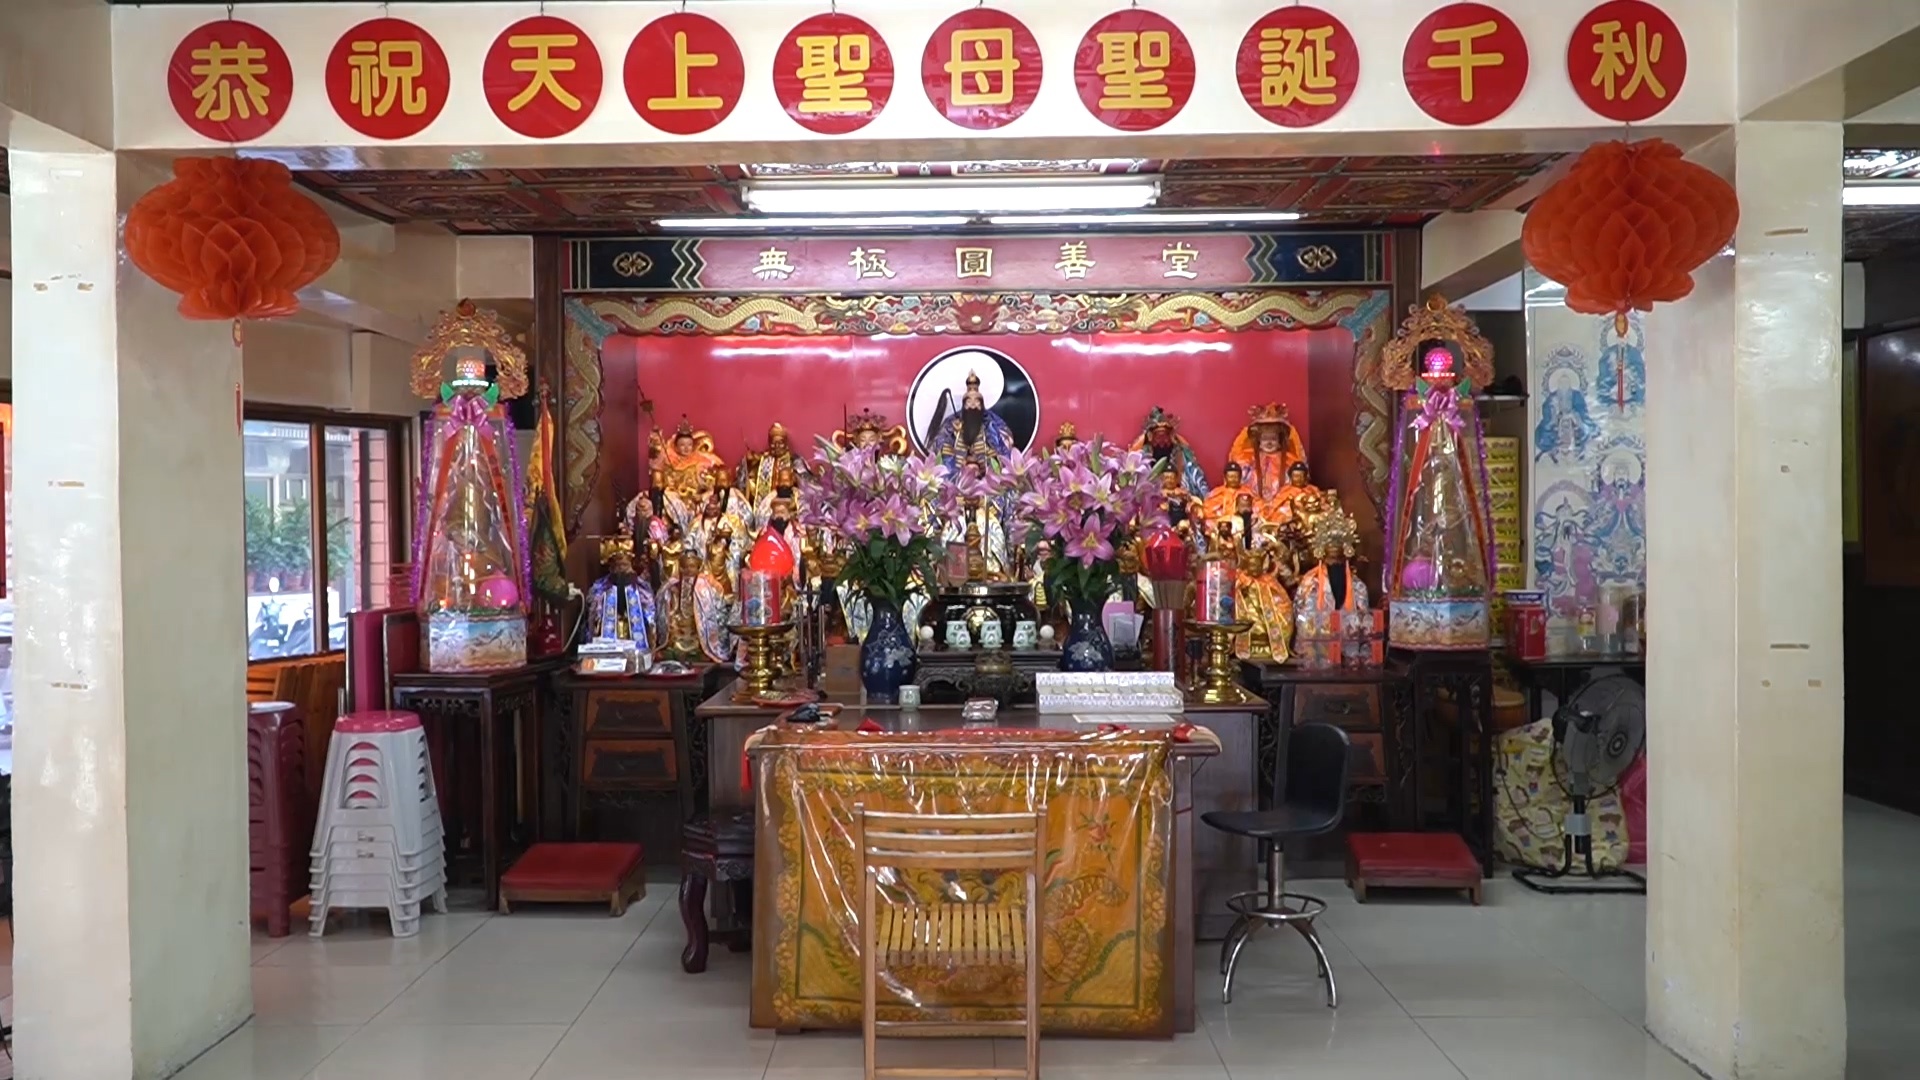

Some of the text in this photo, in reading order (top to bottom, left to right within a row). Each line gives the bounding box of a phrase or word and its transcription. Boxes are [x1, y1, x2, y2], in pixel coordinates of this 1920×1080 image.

[190, 20, 1665, 122] 恭祝天上聖母聖誕千秋
[751, 241, 1199, 280] 無極圓善堂
